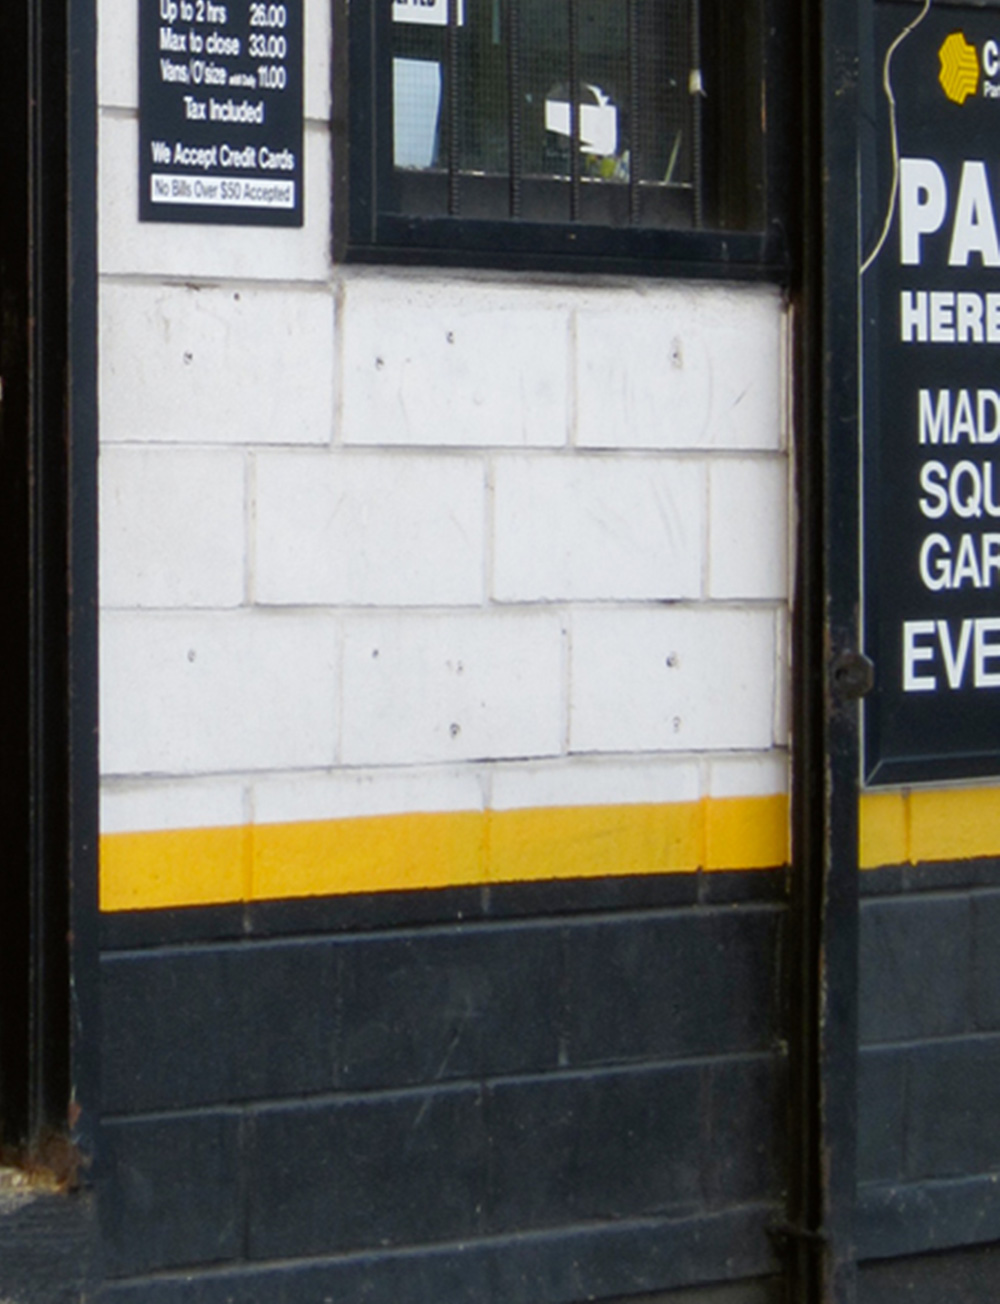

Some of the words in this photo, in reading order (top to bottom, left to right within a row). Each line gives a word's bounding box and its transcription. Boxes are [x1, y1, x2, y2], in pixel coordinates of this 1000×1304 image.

[180, 0, 194, 22] to
[206, 0, 227, 24] hrs
[249, 2, 287, 28] 26.00
[160, 27, 187, 52] Max
[188, 29, 203, 53] to
[205, 31, 241, 55] close
[248, 33, 287, 59] 33.00
[257, 65, 287, 90] 11.00
[183, 95, 207, 120] Tax
[209, 98, 264, 124] Included
[151, 140, 171, 164] We
[173, 142, 218, 170] Accept
[219, 144, 256, 168] Credit
[258, 146, 295, 171] Cards
[155, 178, 170, 197] No
[171, 178, 192, 197] Bills
[194, 179, 218, 198] Over
[220, 180, 242, 200] $50
[243, 182, 291, 204] Accepted
[919, 388, 1000, 444] MAD
[919, 532, 1000, 591] GAR
[902, 617, 1000, 692] EVE
